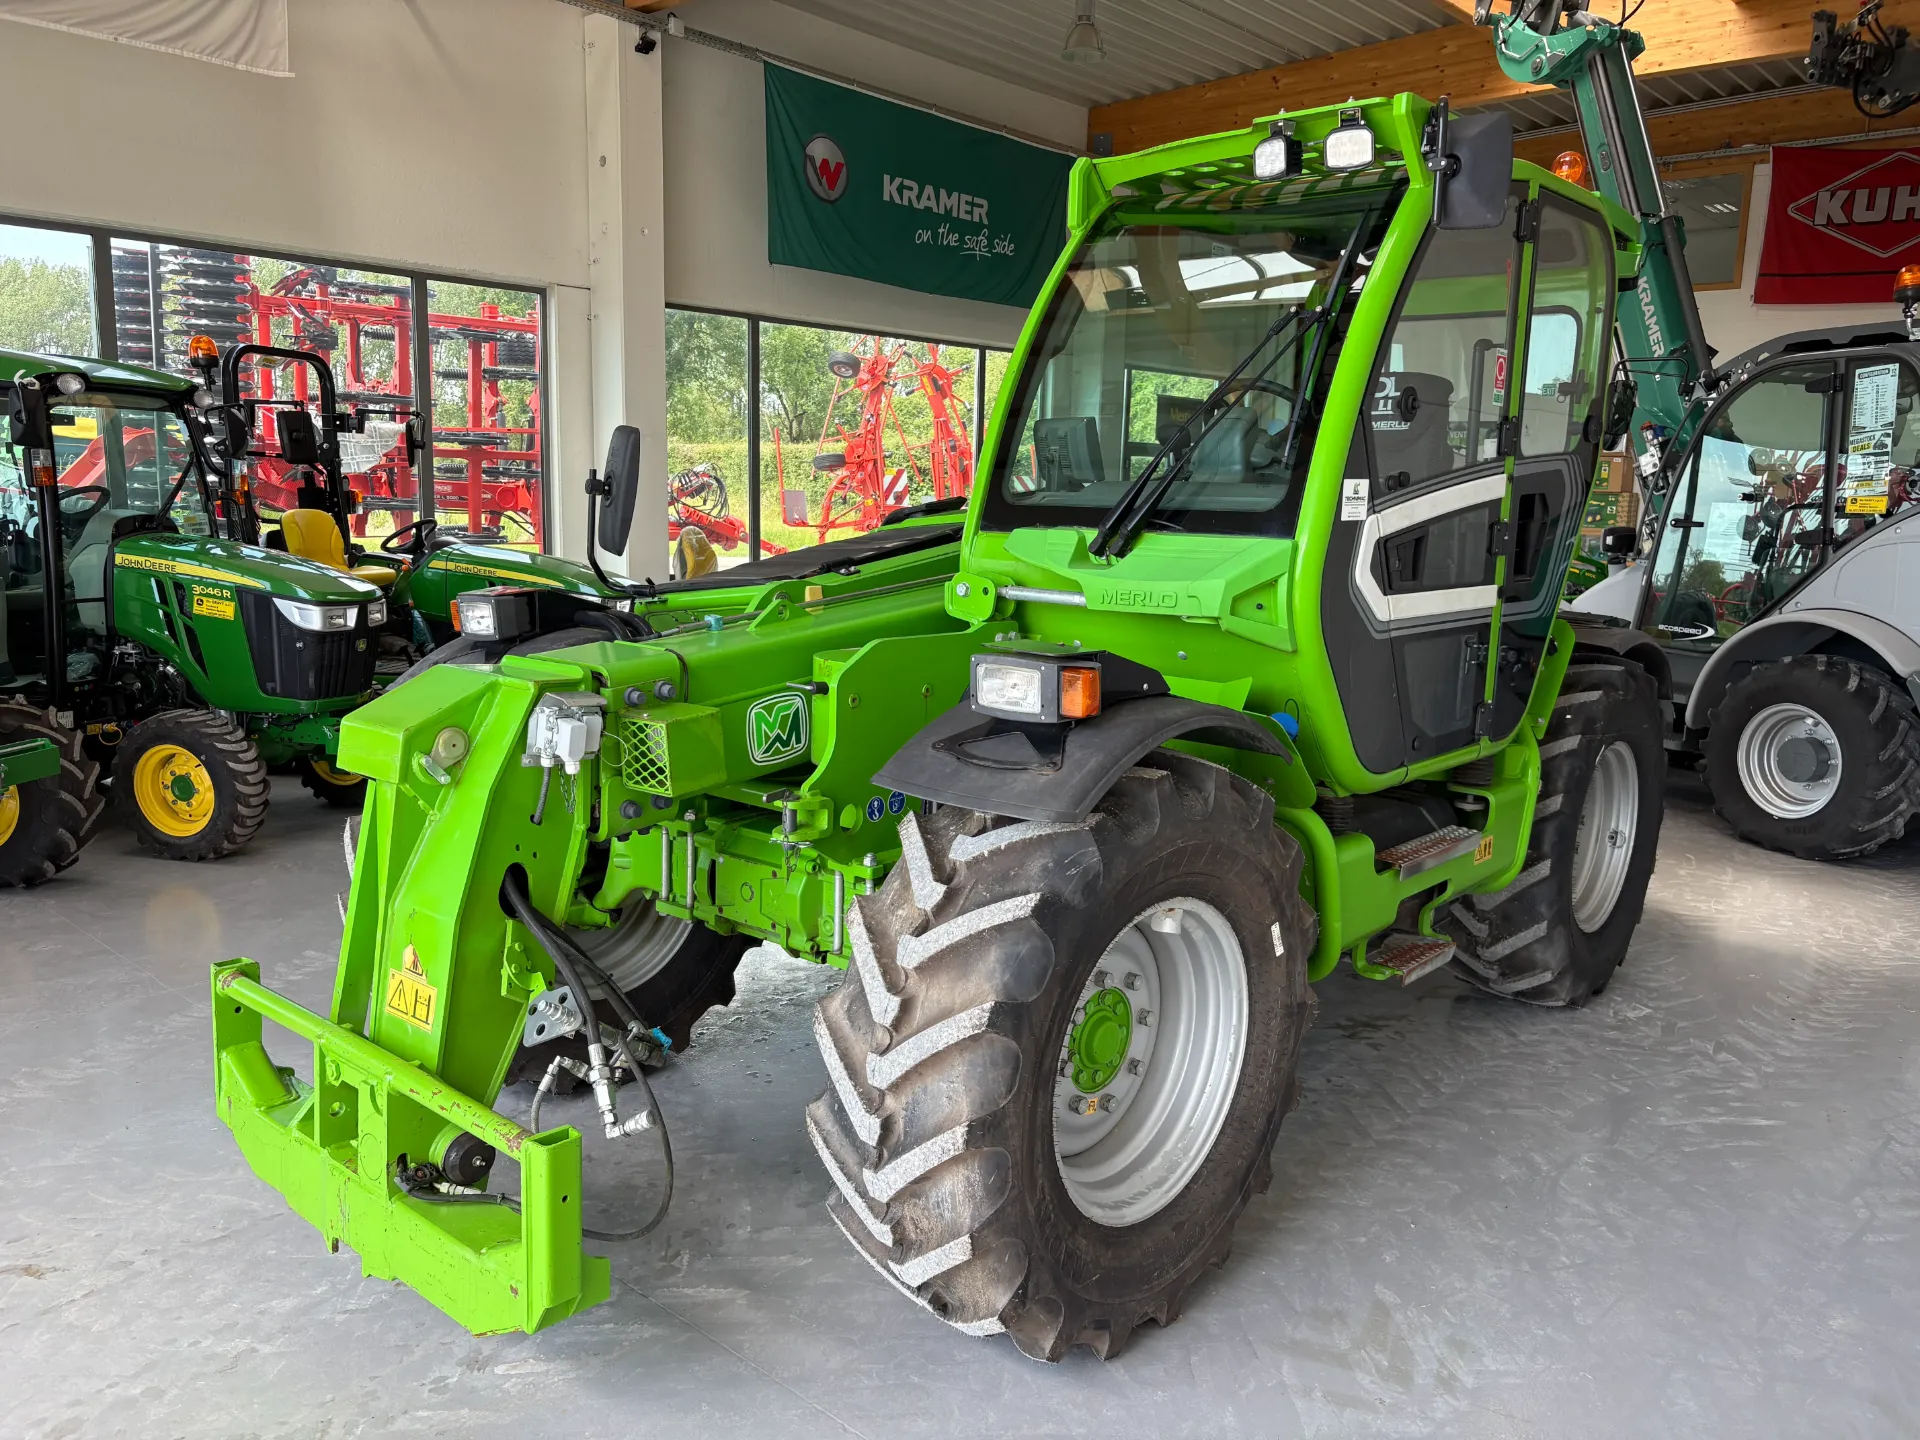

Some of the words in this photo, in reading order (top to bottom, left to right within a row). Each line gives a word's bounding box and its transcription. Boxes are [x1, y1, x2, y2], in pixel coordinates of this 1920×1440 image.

[883, 174, 989, 225] KRAMER
[915, 228, 934, 245] on
[938, 222, 960, 247] the
[963, 228, 989, 260] safe
[992, 233, 1015, 256] side
[1637, 275, 1665, 357] KRAMER
[1852, 443, 1871, 453] DEALS
[118, 556, 144, 569] JOHN
[144, 559, 177, 573] DEERE
[452, 563, 472, 573] JOHN
[472, 566, 498, 577] DEERE
[191, 584, 222, 597] 3046
[223, 589, 231, 599] R
[1100, 589, 1178, 609] MERLO
[1658, 624, 1702, 635] ecospeed
